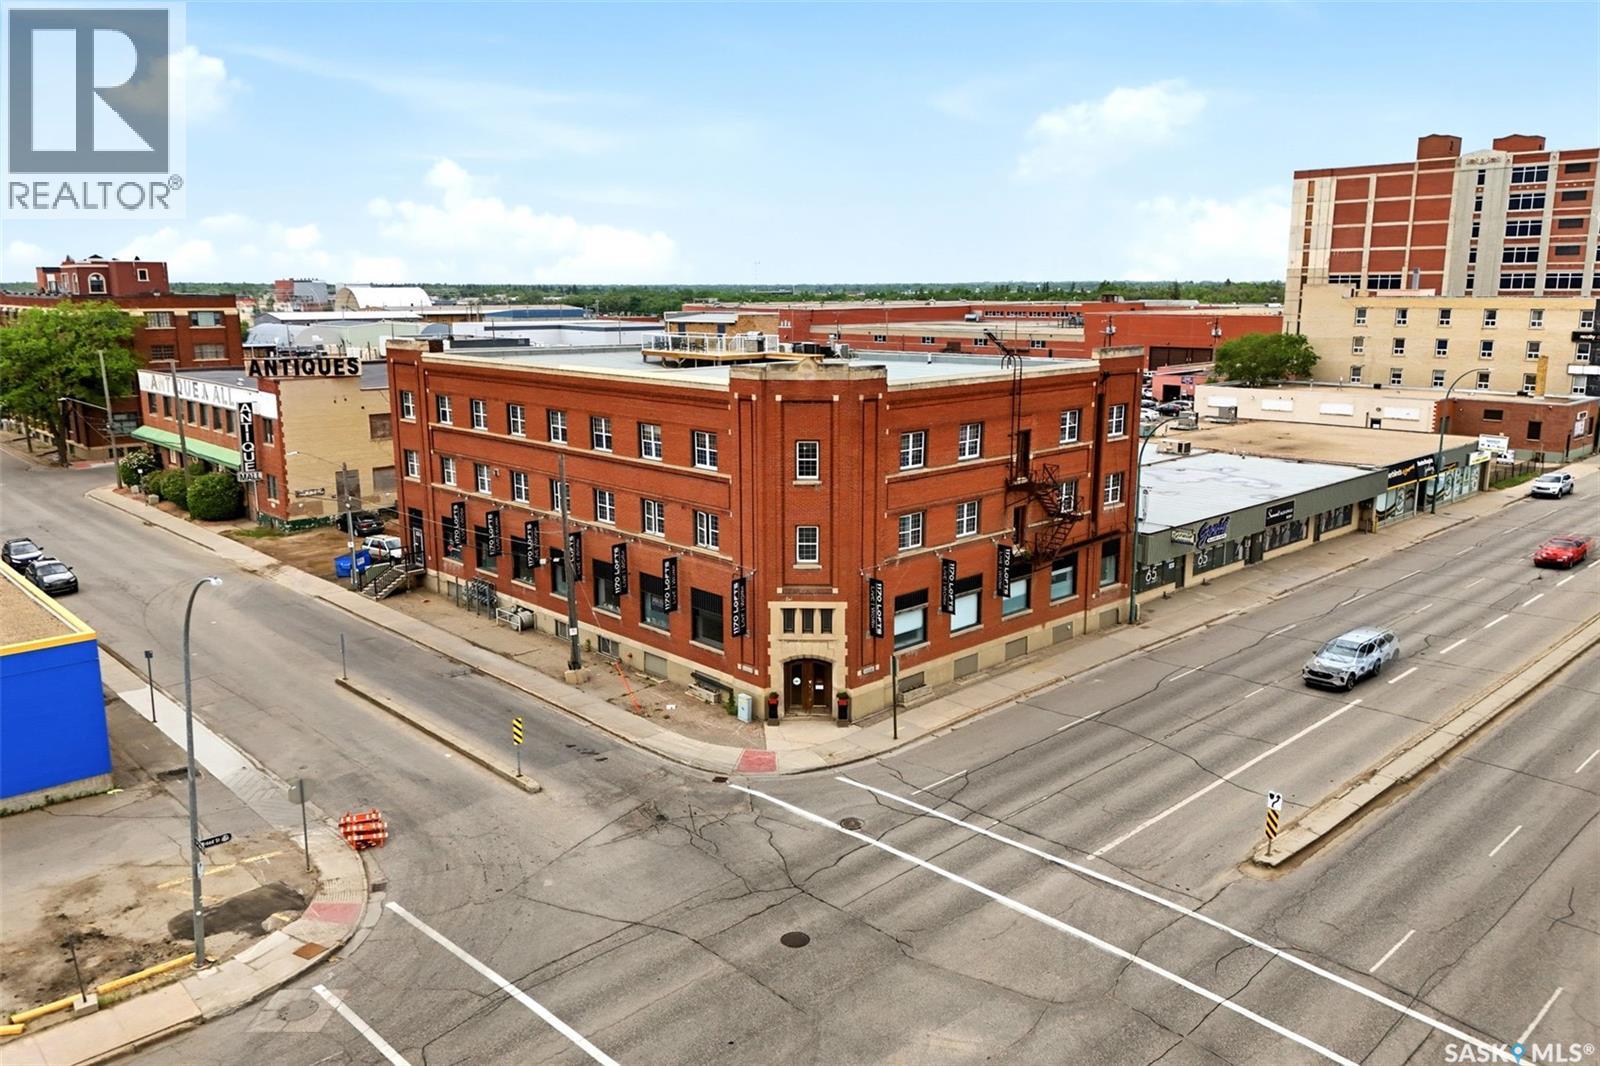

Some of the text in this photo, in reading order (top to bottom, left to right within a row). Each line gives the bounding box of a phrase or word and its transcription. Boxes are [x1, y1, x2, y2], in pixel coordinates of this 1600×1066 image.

[249, 358, 360, 377] ANTIQUES
[240, 403, 255, 472] ANTIQUE
[1197, 551, 1208, 566] 65
[1145, 567, 1158, 582] 65
